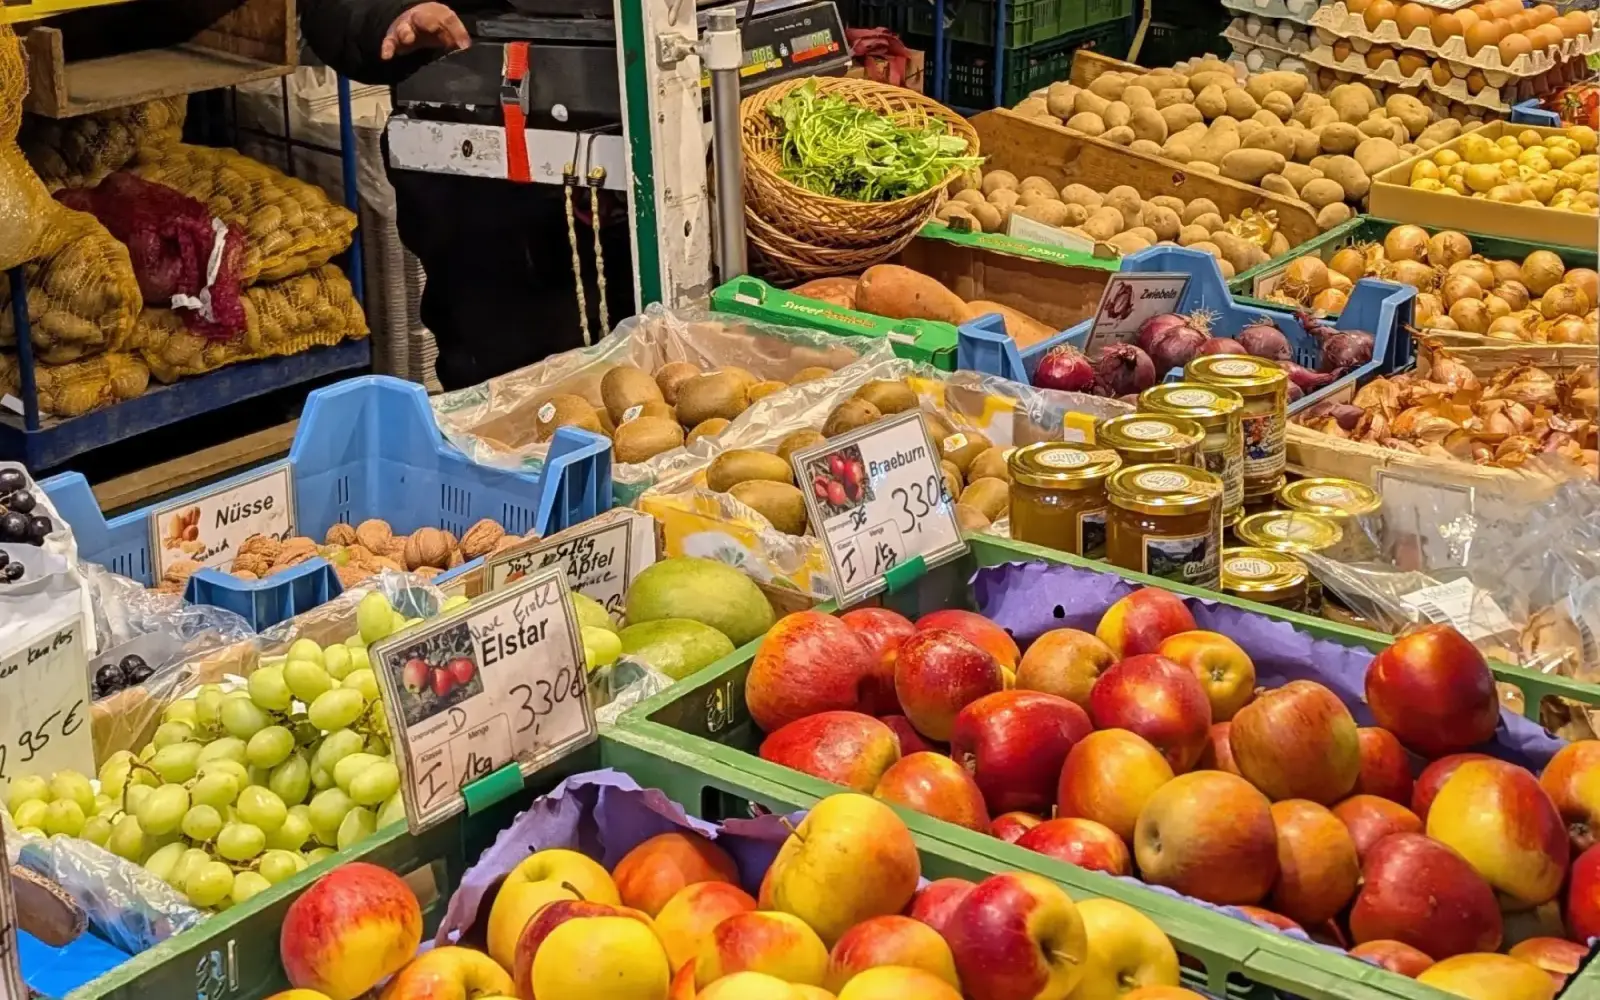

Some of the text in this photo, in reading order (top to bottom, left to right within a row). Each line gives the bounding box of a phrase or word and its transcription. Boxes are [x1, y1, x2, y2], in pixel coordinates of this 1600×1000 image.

[1140, 288, 1177, 300] Zwiebeln
[869, 445, 926, 478] Braeburn
[215, 494, 274, 530] Nüsse
[482, 617, 549, 668] Elstar
